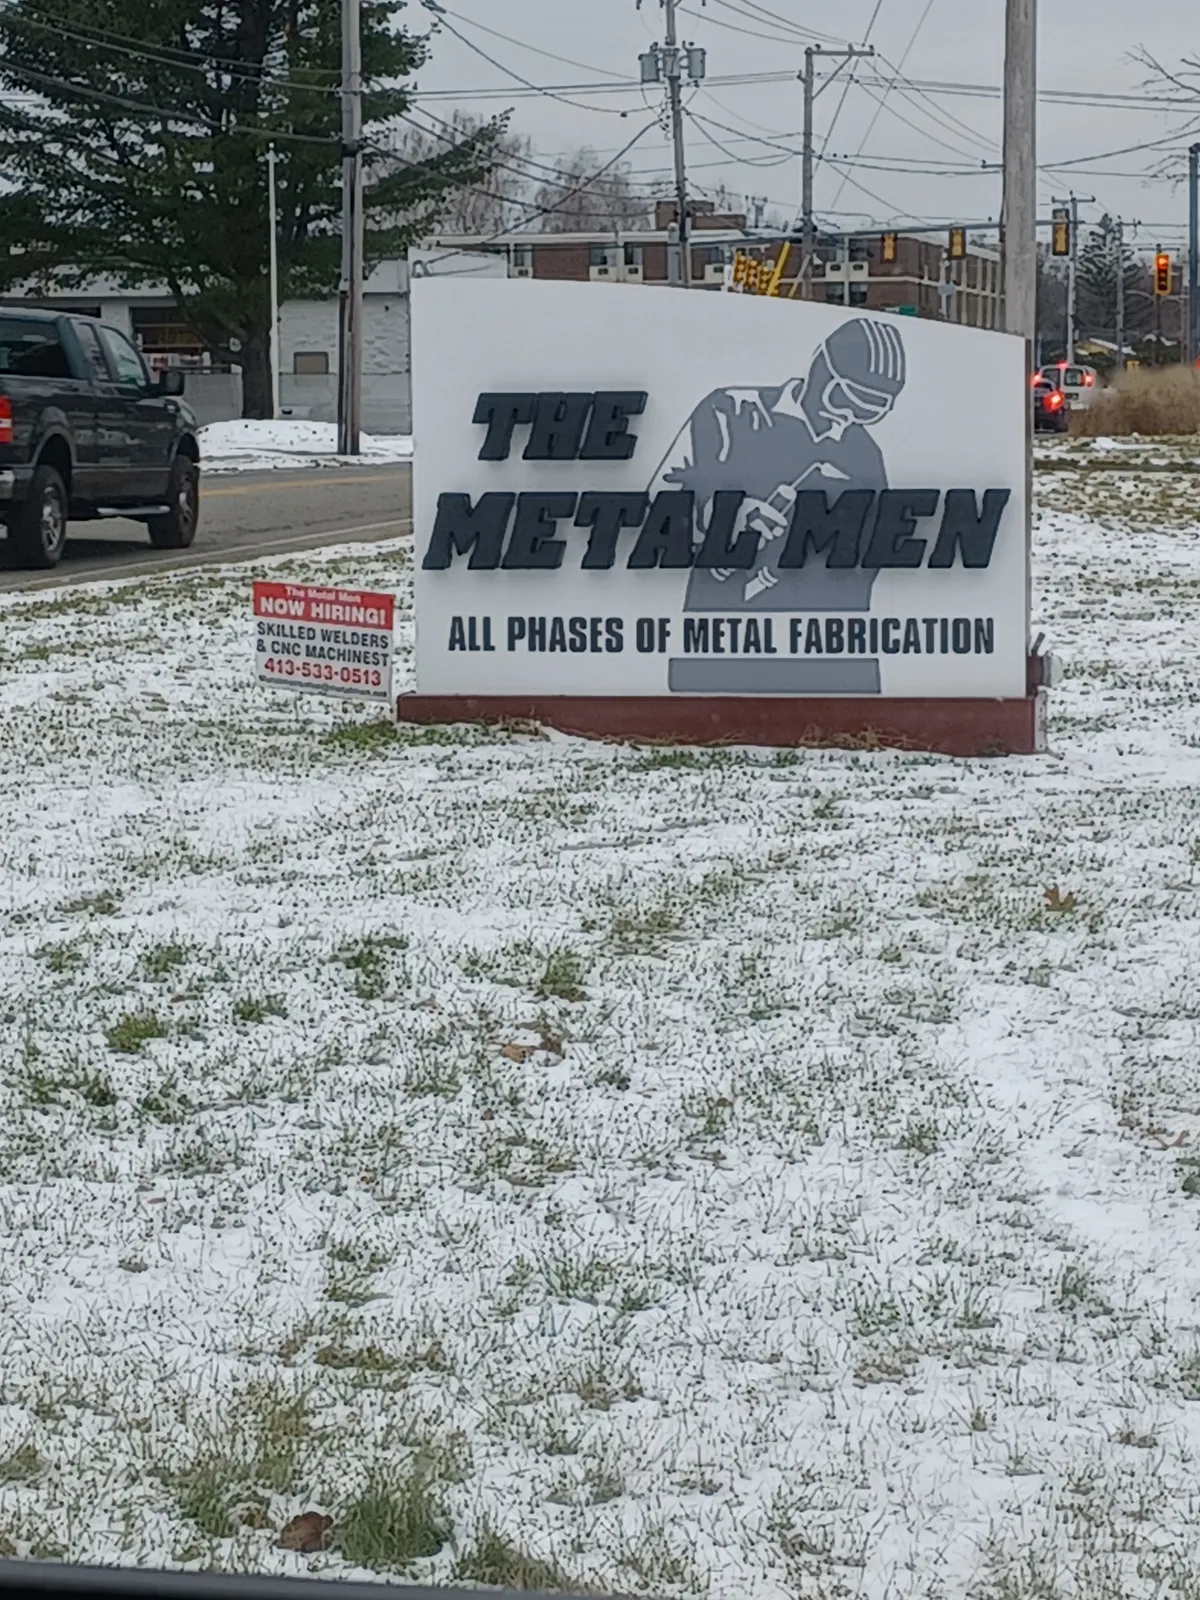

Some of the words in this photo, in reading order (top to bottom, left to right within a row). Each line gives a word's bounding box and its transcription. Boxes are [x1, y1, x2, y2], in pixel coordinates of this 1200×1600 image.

[472, 391, 648, 460] THE
[422, 490, 762, 570] METAL
[778, 488, 1011, 568] MEN
[260, 597, 305, 616] NOW
[310, 602, 386, 625] HIRING!
[257, 621, 316, 641] SKILLED
[320, 628, 389, 649] WELDERS
[448, 616, 495, 651] ALL
[507, 616, 623, 653] PHASES
[636, 617, 671, 653] OF
[683, 618, 777, 653] METAL
[789, 617, 994, 654] FABRICATION
[256, 639, 266, 653] &
[271, 640, 301, 656] CNC
[305, 644, 389, 667] MACHINEST
[264, 657, 381, 686] 413-533-0513
